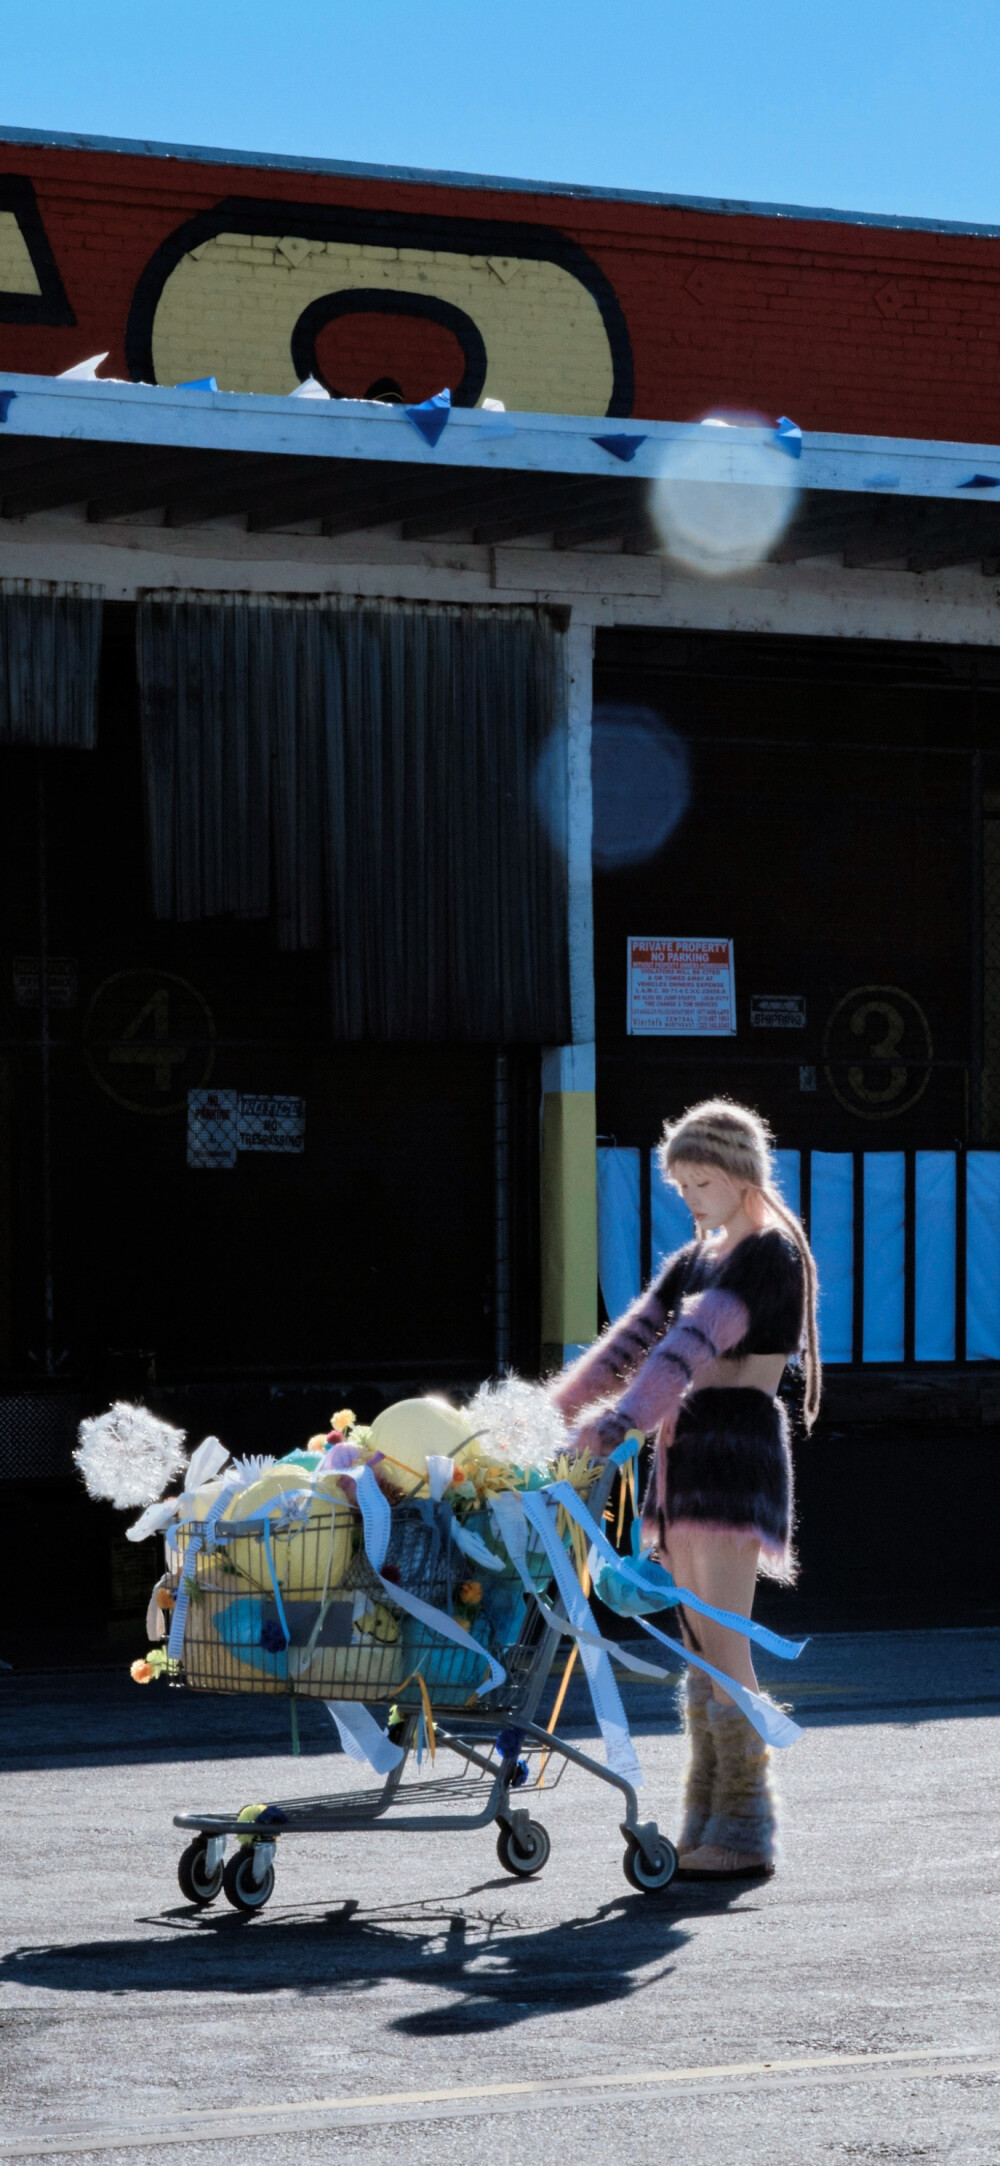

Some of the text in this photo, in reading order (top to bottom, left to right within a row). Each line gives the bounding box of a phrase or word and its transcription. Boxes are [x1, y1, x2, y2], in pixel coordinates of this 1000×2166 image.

[632, 941, 727, 953] PRIVATE PROPERTY
[651, 952, 710, 963] NO PARKING
[108, 989, 187, 1092] 4
[848, 1001, 907, 1103] 3
[241, 1101, 299, 1115] NOTICE
[263, 1118, 277, 1131] NO
[240, 1132, 304, 1147] TRESPASSING
